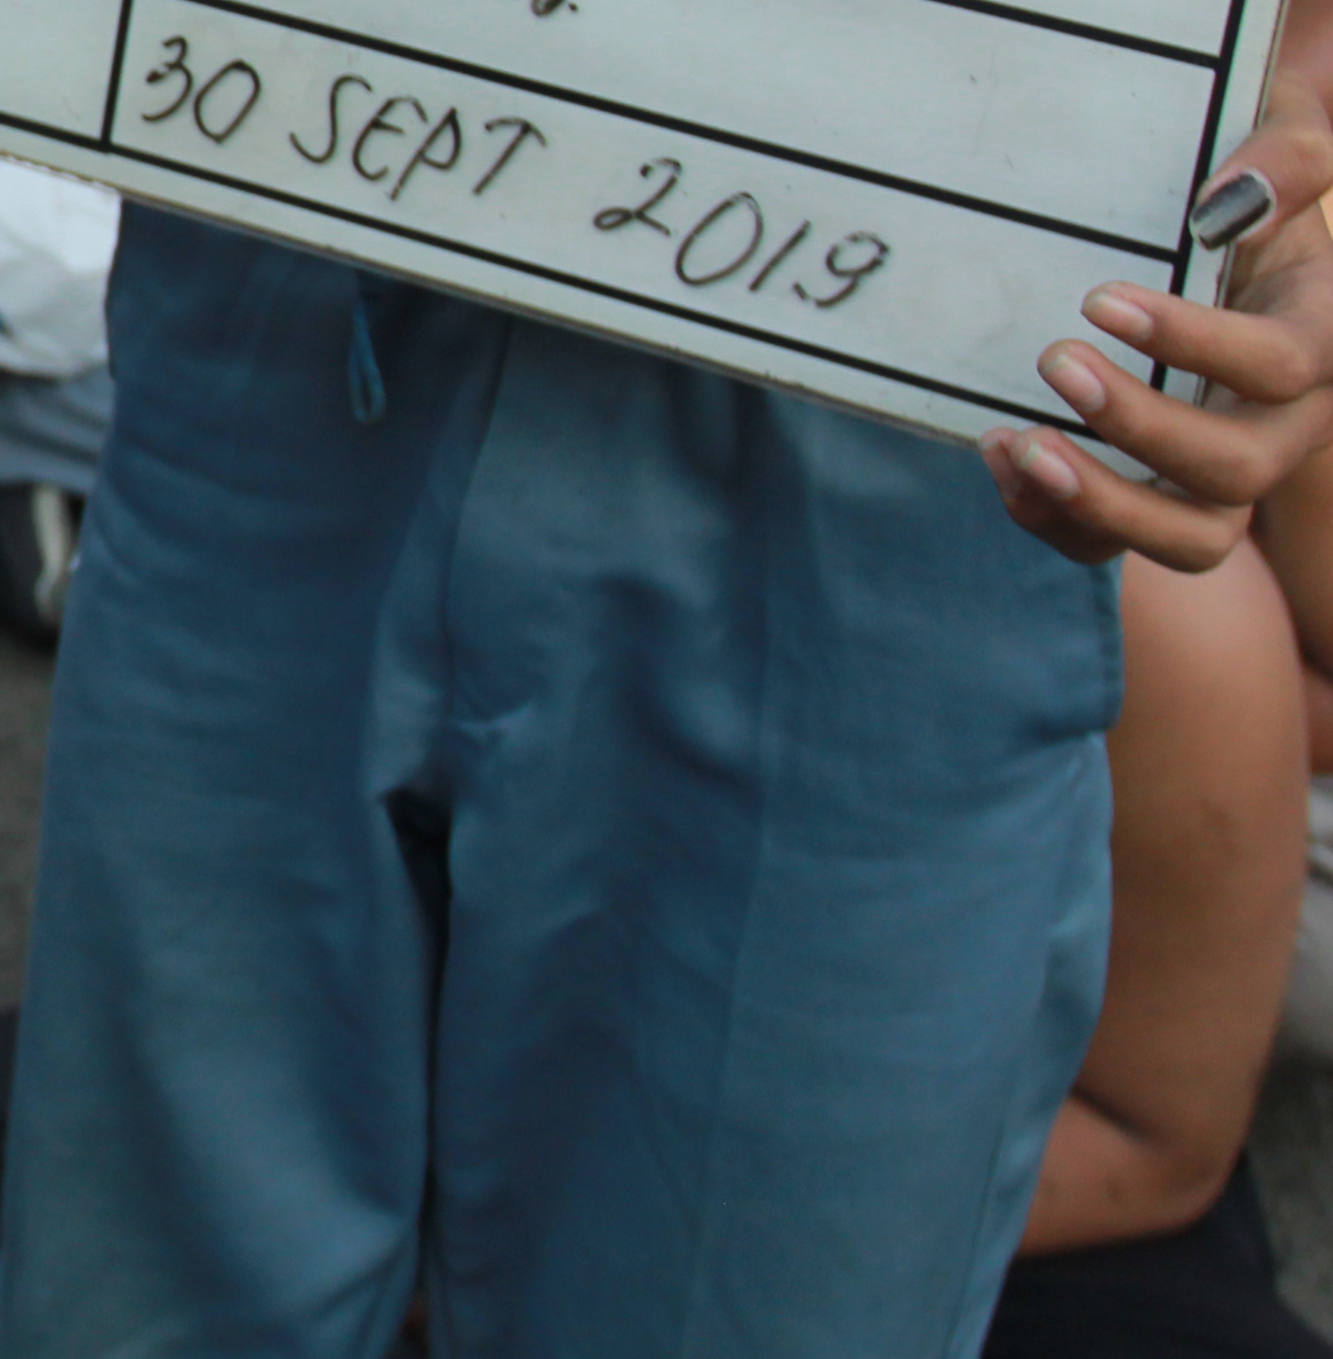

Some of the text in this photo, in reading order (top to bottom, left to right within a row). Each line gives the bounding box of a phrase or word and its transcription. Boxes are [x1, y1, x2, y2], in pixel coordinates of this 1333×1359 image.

[140, 34, 892, 310] 30 SEPT 2019
